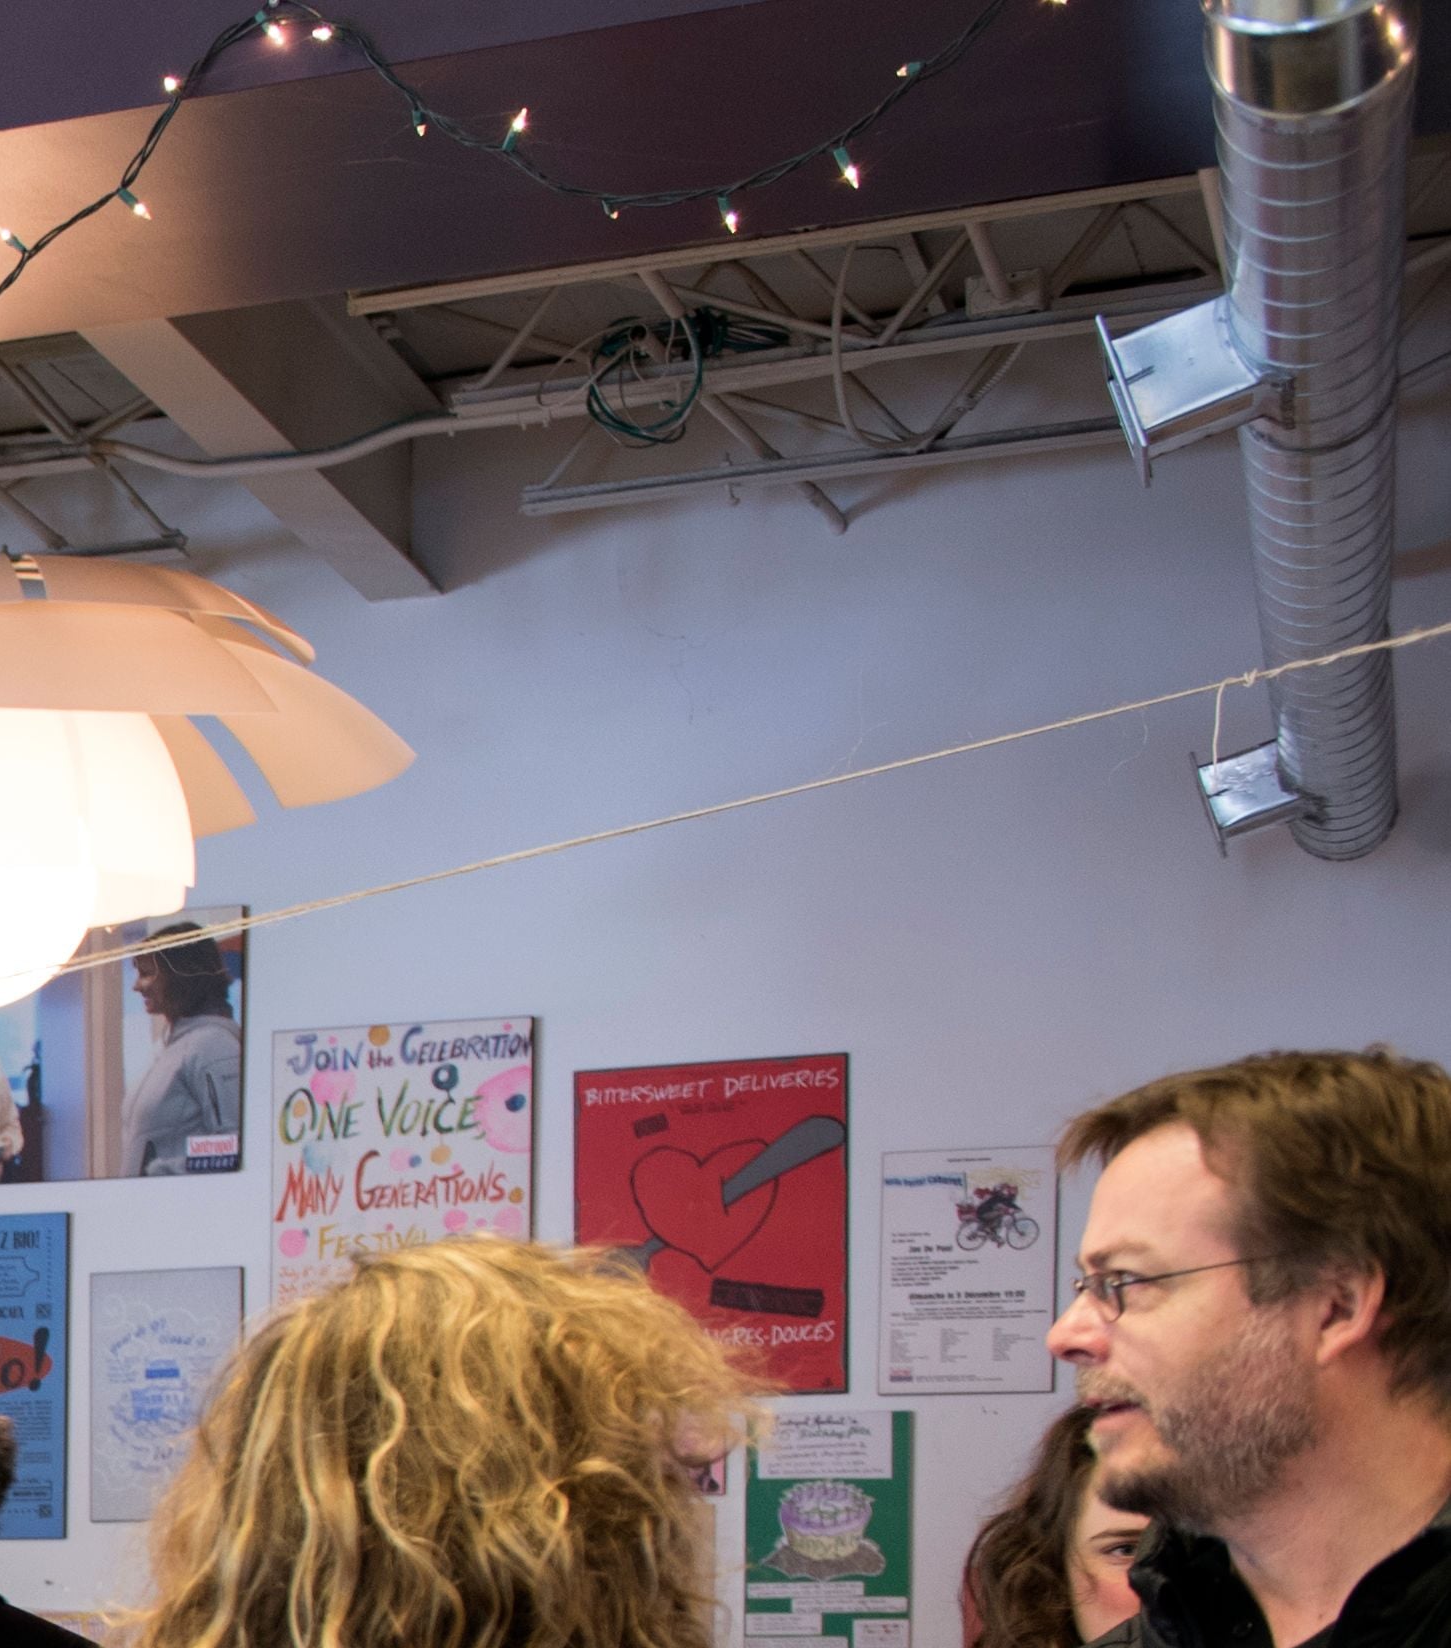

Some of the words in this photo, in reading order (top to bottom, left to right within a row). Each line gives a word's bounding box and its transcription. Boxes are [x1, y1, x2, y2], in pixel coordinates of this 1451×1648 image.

[585, 1079, 715, 1106] BITTERSWEET
[725, 1068, 840, 1098] DELIVERIES
[279, 1088, 364, 1144] ONE
[274, 1160, 344, 1222] MANY
